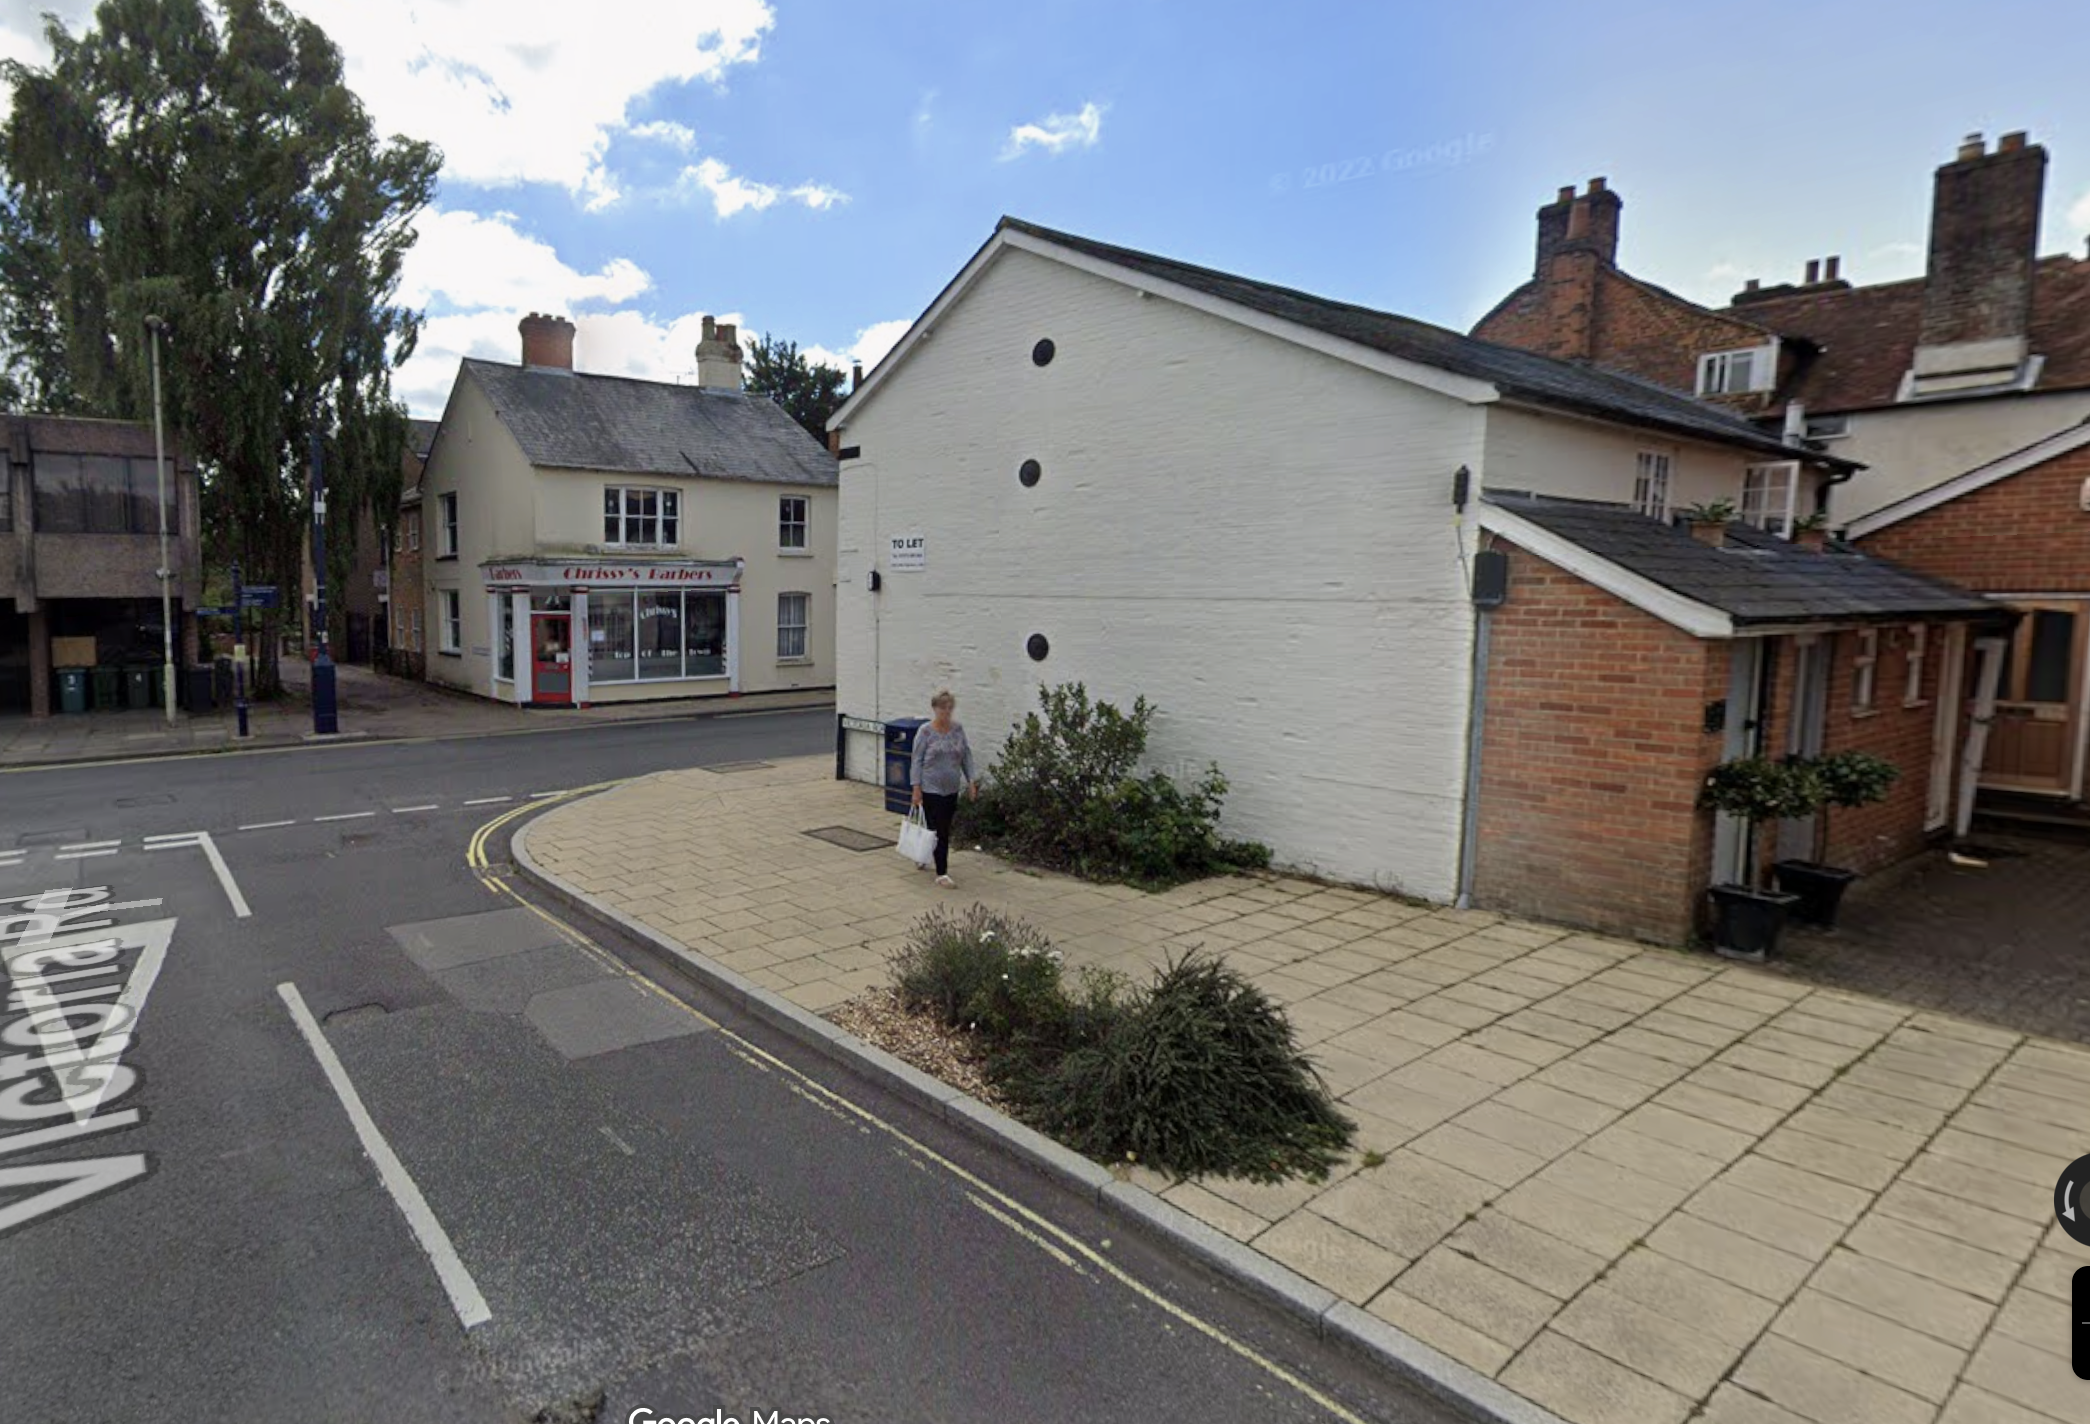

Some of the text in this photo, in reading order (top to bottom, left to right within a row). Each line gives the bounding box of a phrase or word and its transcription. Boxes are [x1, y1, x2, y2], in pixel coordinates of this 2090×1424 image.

[892, 538, 924, 549] TO LET
[563, 567, 713, 581] Chrissy's Barbers
